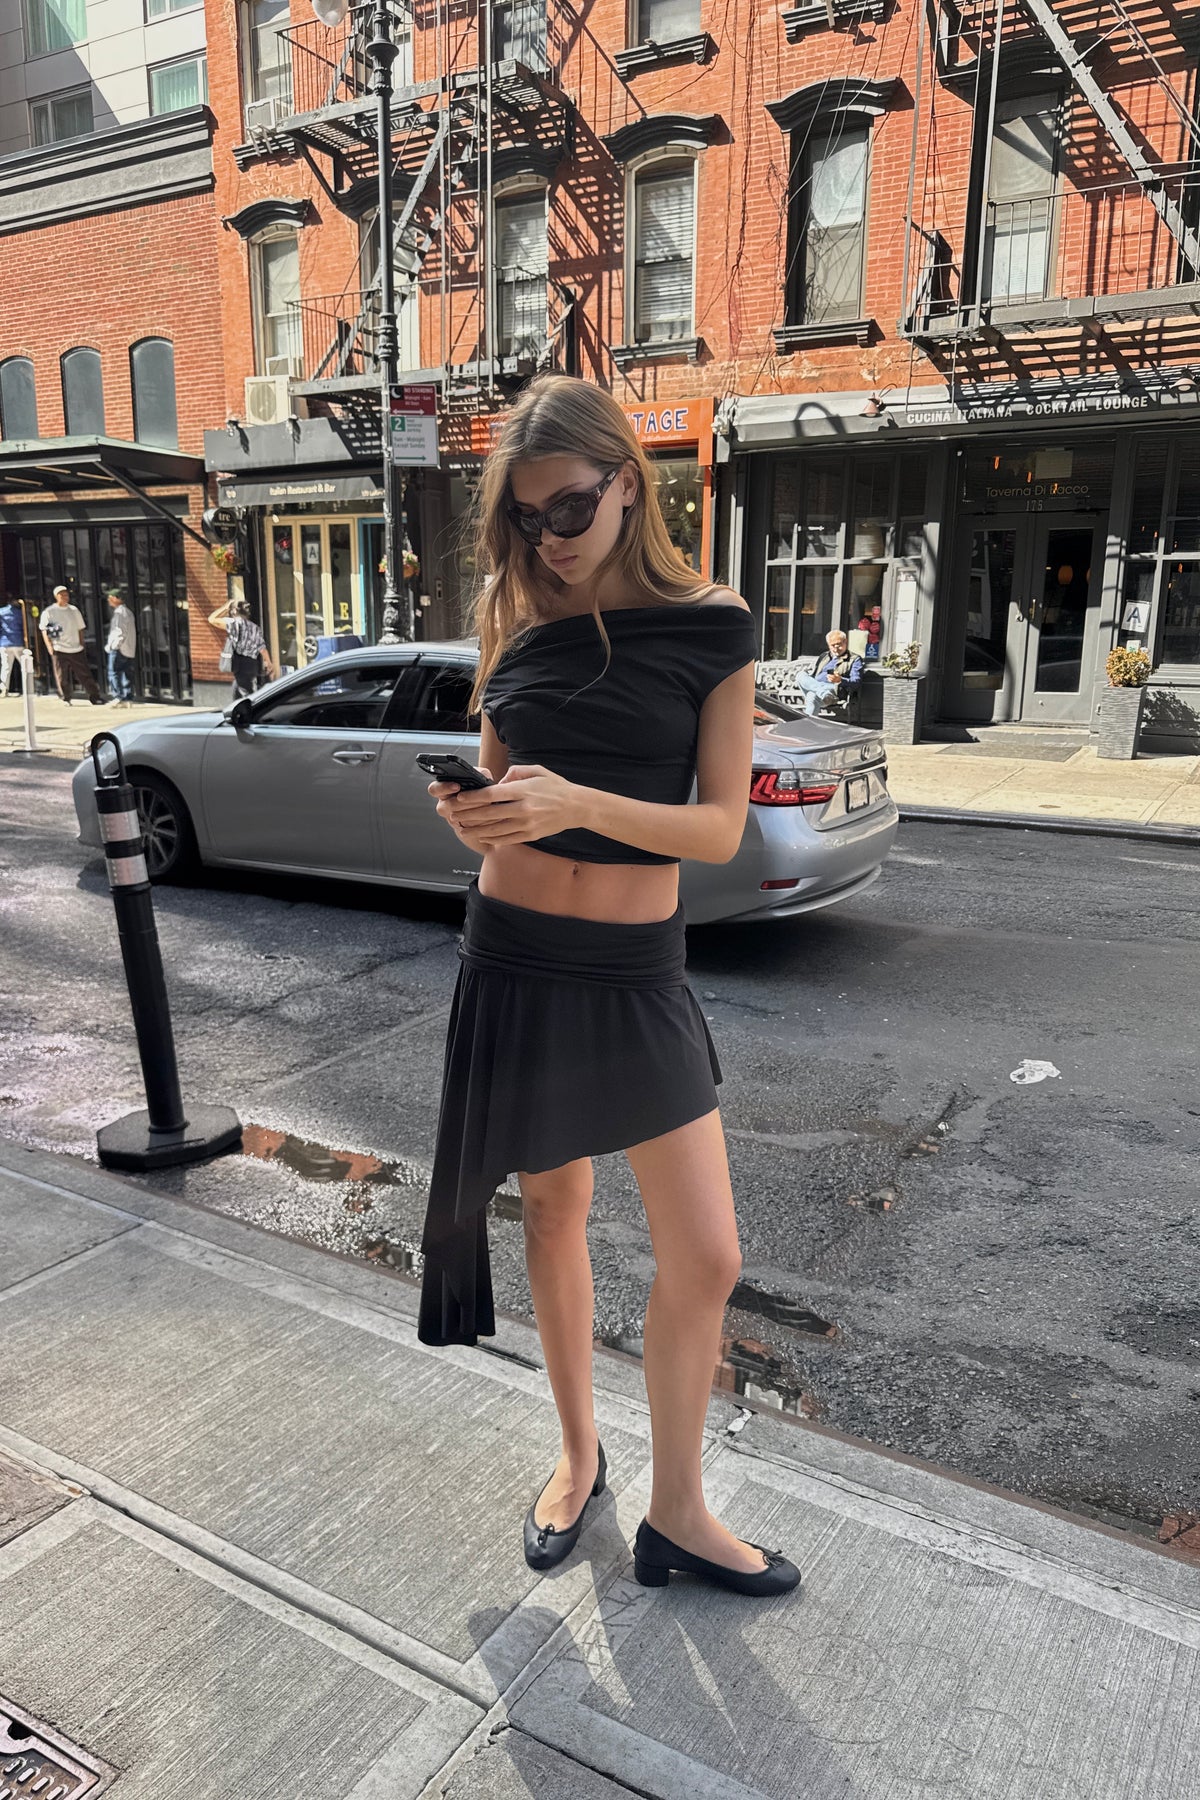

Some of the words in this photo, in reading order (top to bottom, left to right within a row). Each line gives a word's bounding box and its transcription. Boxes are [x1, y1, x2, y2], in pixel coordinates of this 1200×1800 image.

[906, 411, 951, 424] CUCINA
[957, 405, 1012, 421] ITALIANA
[1026, 400, 1088, 415] COCKTAIL
[1095, 396, 1148, 410] LOUNGE
[394, 418, 402, 431] 2
[627, 408, 688, 434] TAGE
[324, 483, 336, 492] Bar
[986, 487, 1031, 497] Taverna
[1035, 485, 1046, 495] Di
[1026, 499, 1043, 511] 175
[309, 546, 317, 558] A
[1127, 607, 1141, 623] A
